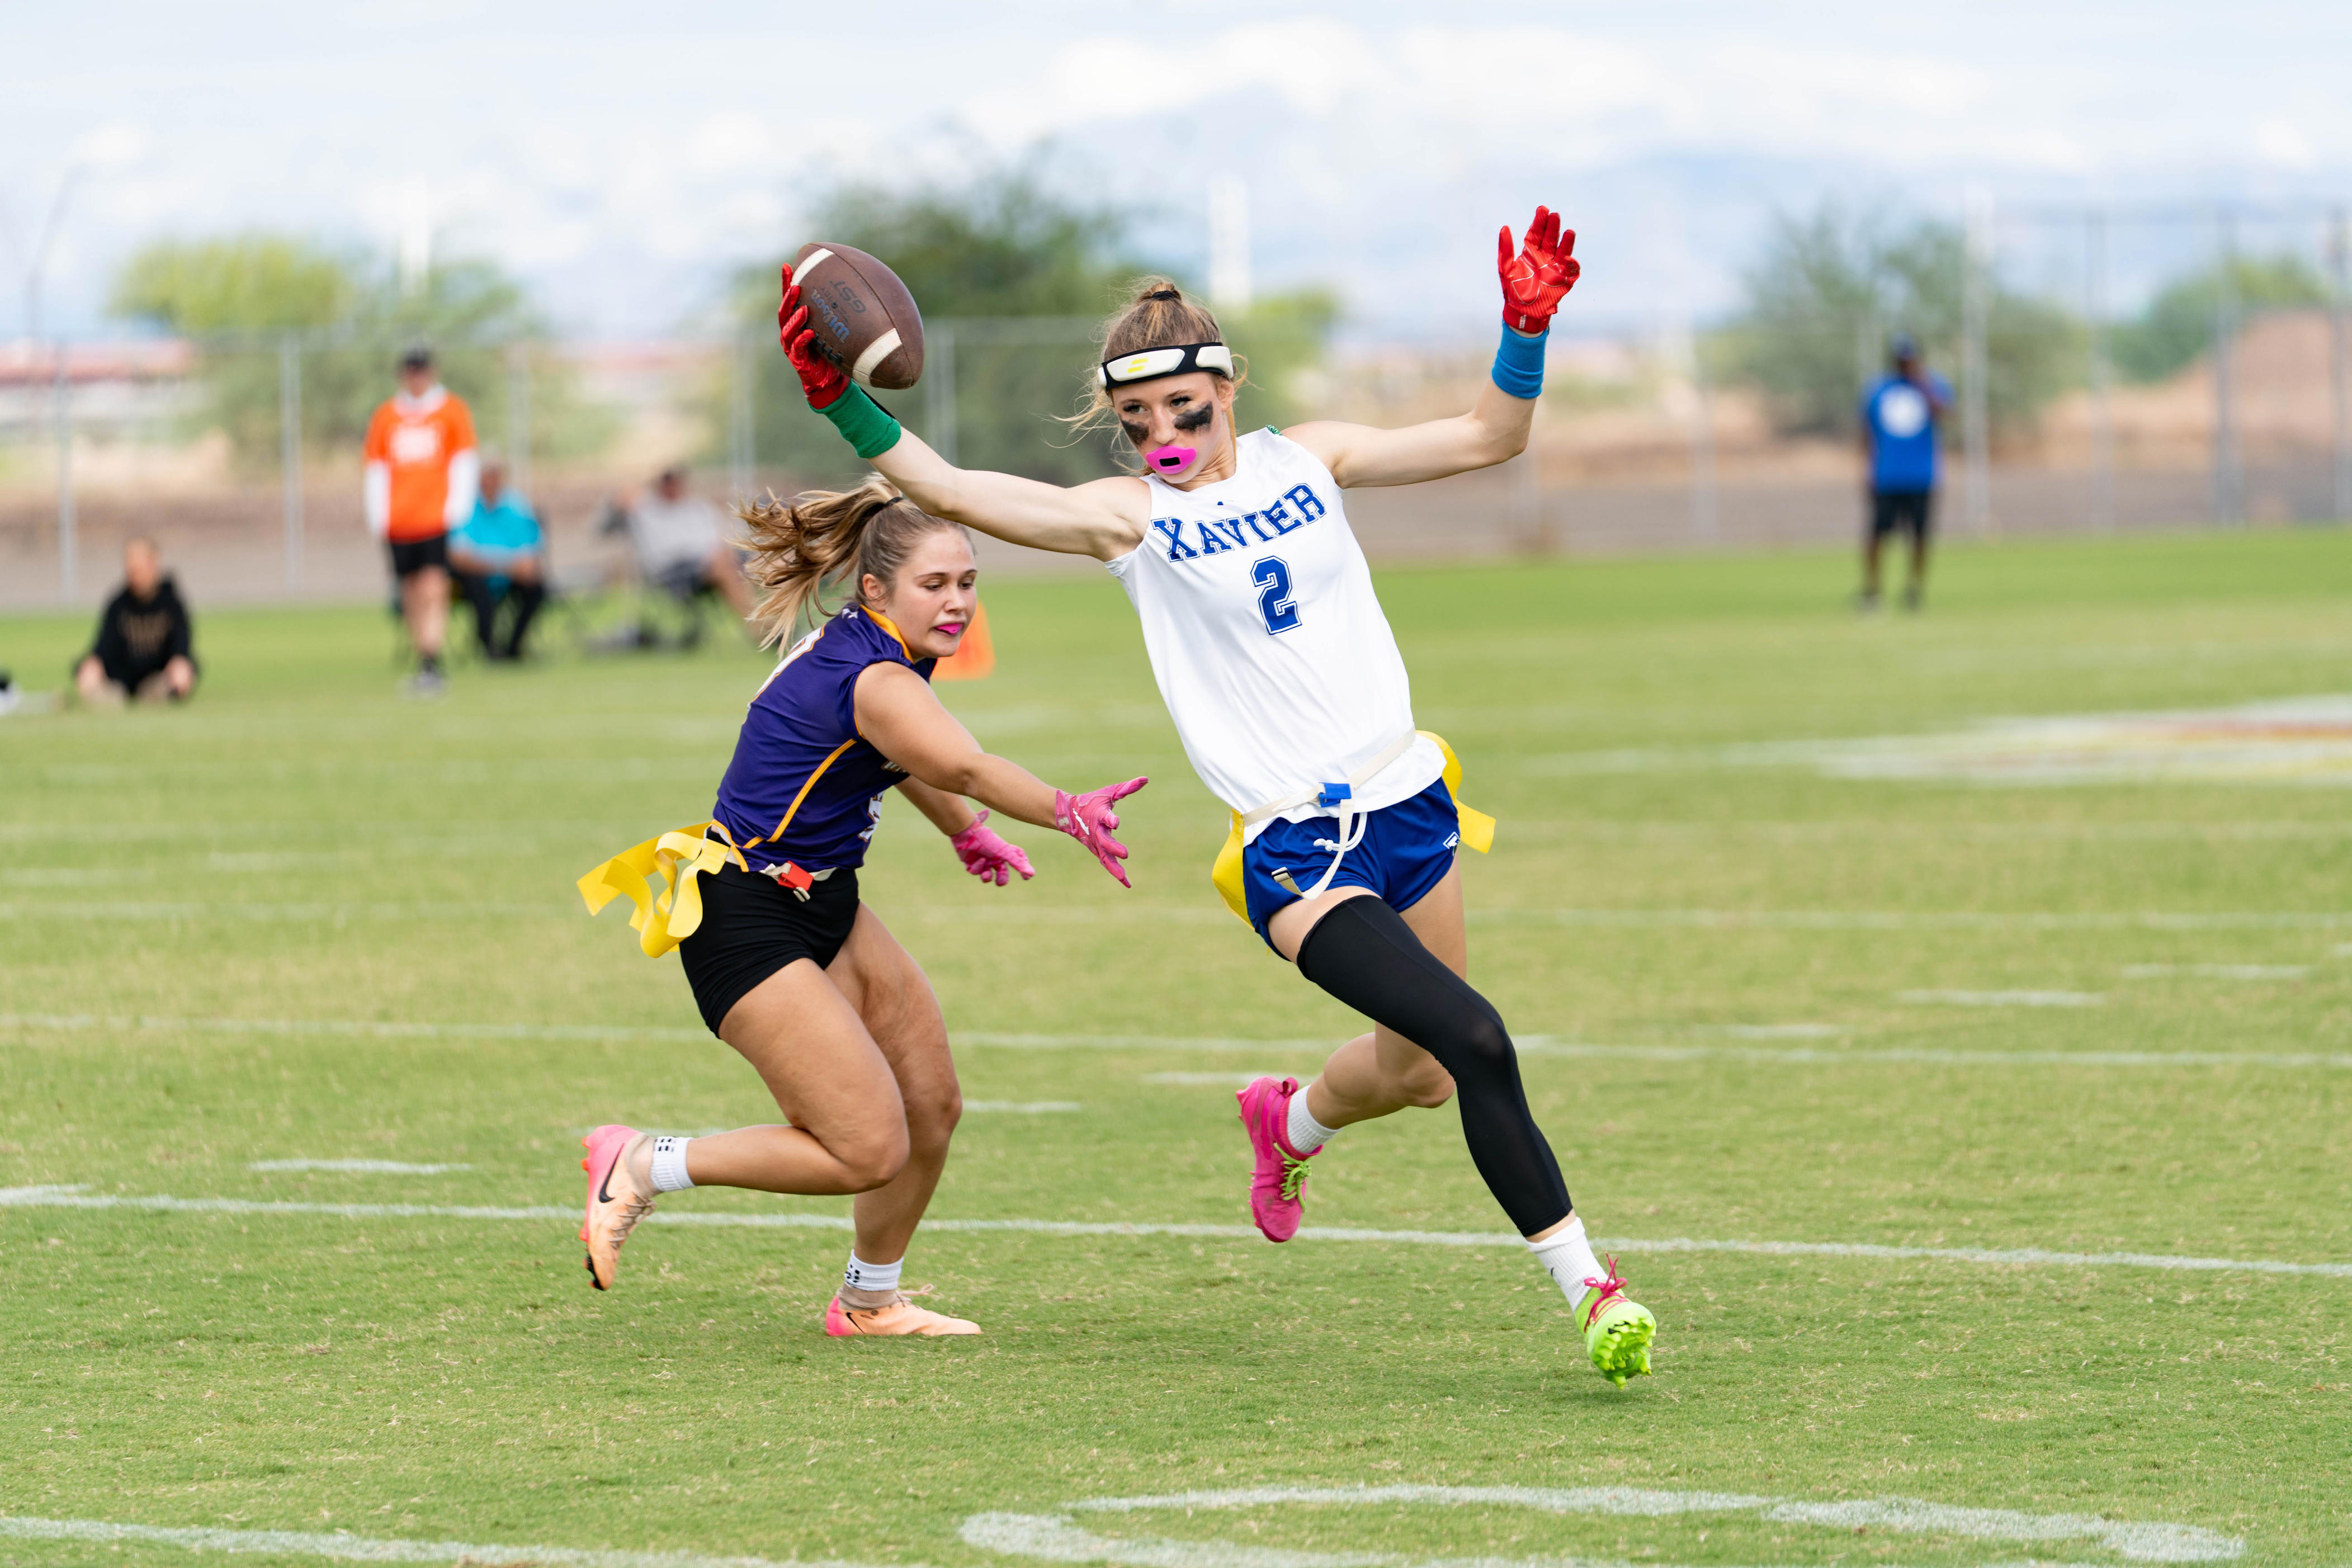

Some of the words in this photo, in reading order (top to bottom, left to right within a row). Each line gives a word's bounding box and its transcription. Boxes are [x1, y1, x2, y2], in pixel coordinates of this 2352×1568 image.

[810, 289, 849, 344] Wilson
[832, 281, 866, 313] GST
[1150, 483, 1327, 563] XAVIER
[1250, 555, 1302, 635] 2
